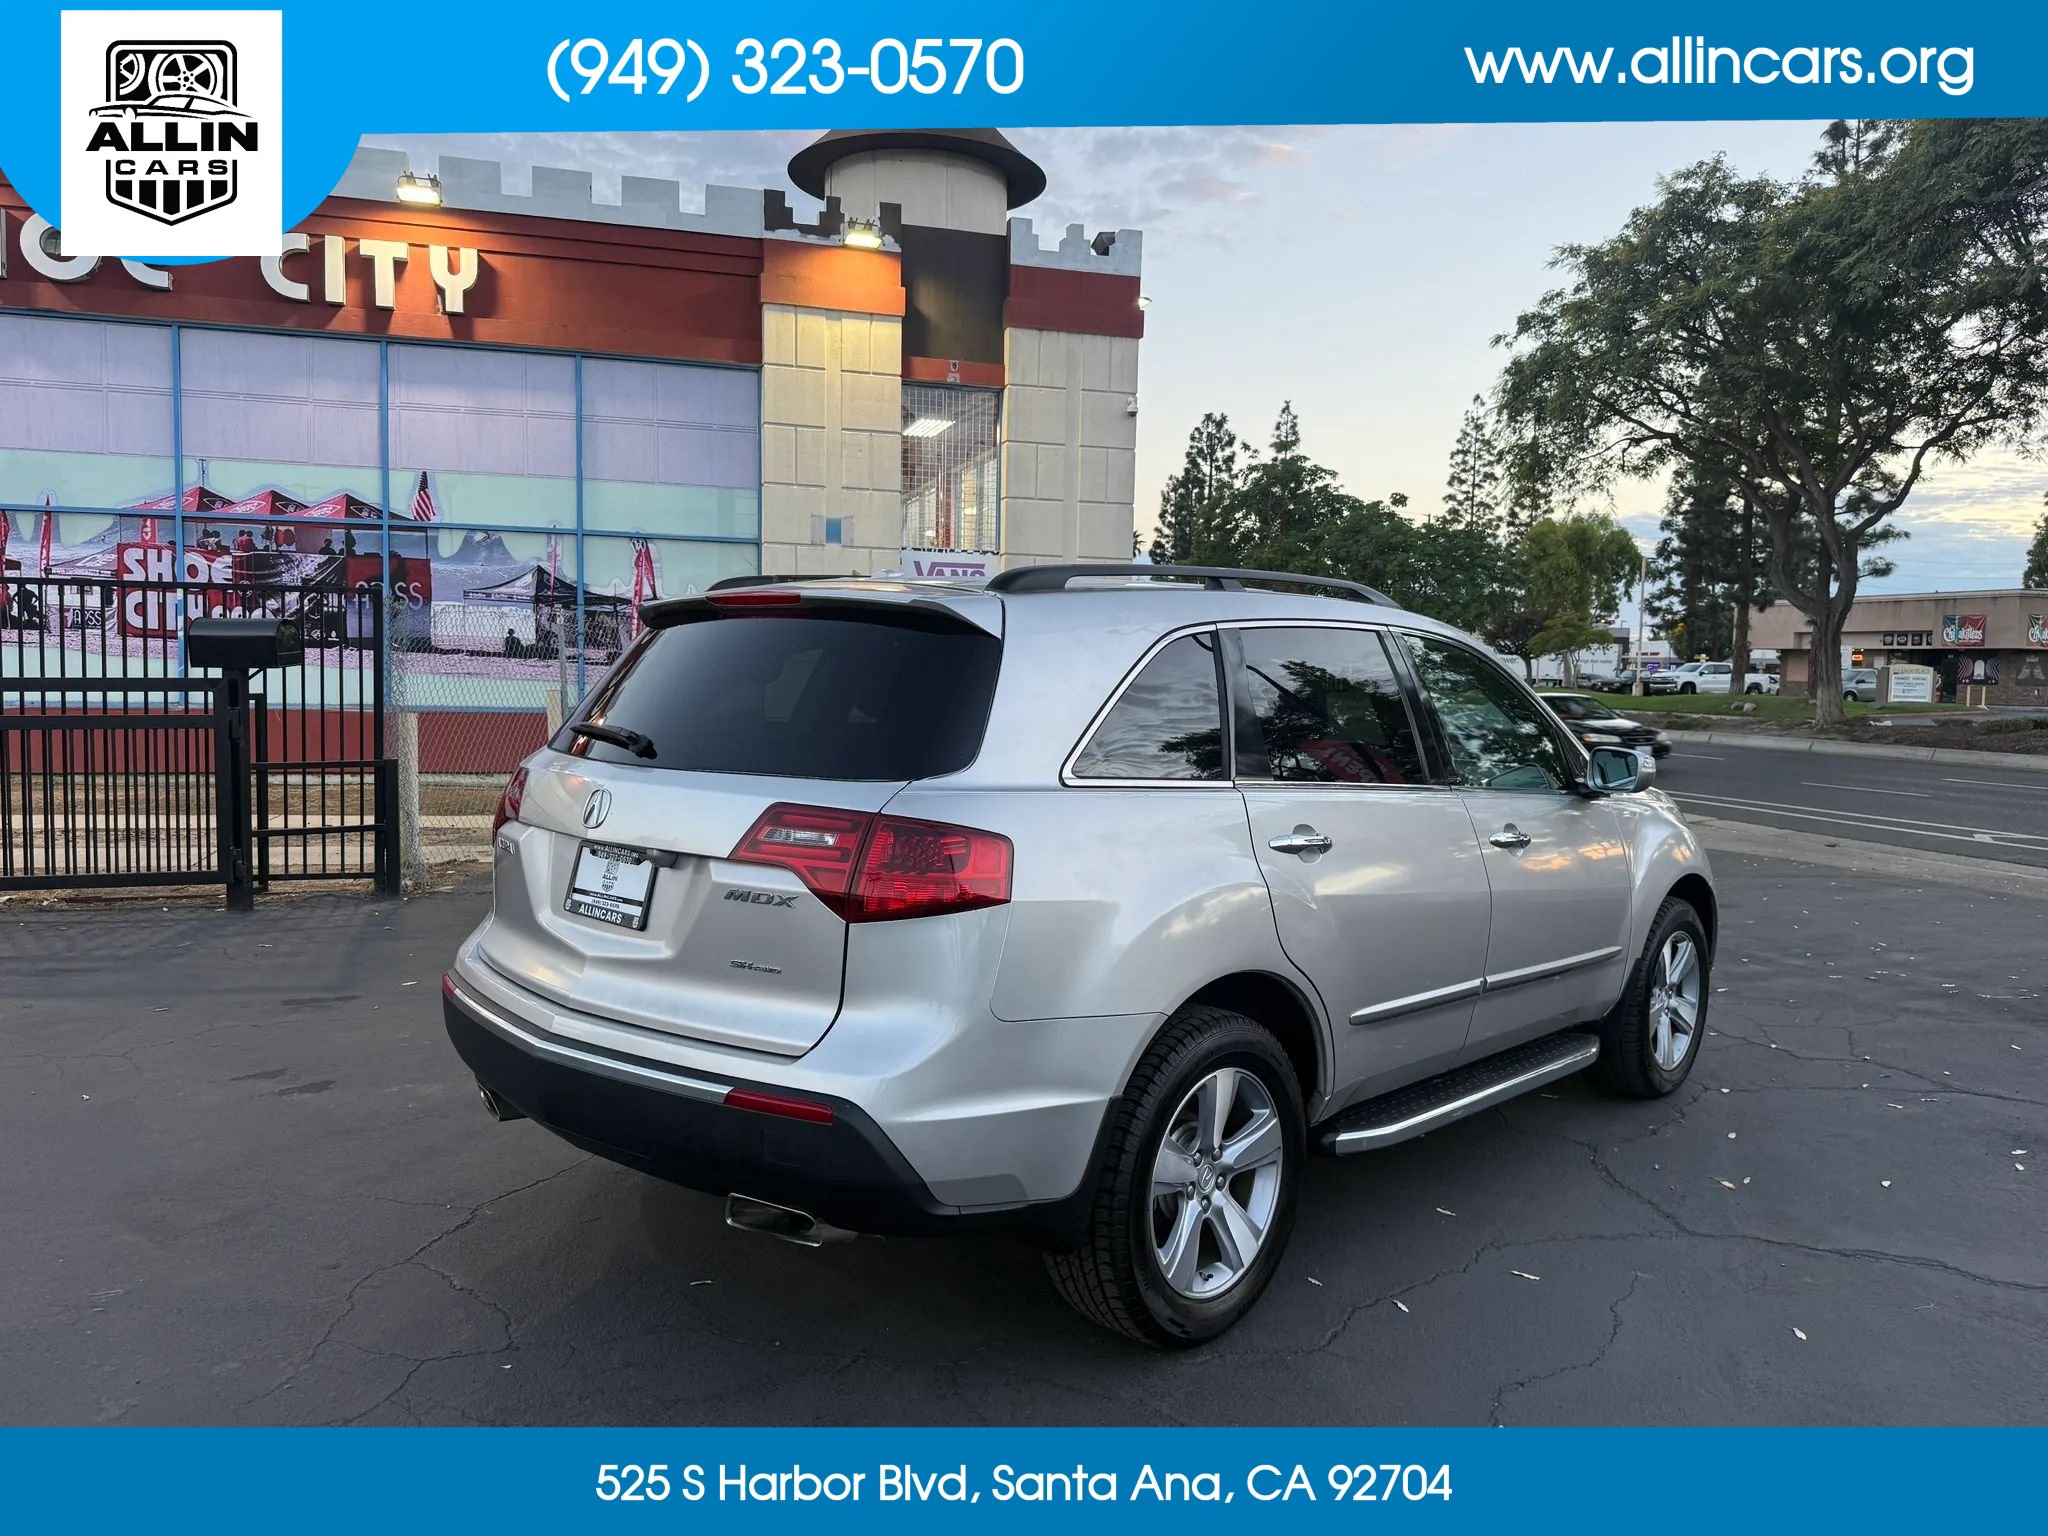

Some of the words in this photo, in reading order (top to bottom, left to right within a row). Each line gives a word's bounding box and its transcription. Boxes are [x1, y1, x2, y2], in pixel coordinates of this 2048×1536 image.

[260, 232, 478, 315] CITY
[352, 581, 423, 610] ASS
[723, 888, 800, 909] MDX
[578, 903, 623, 924] ALLINCARS
